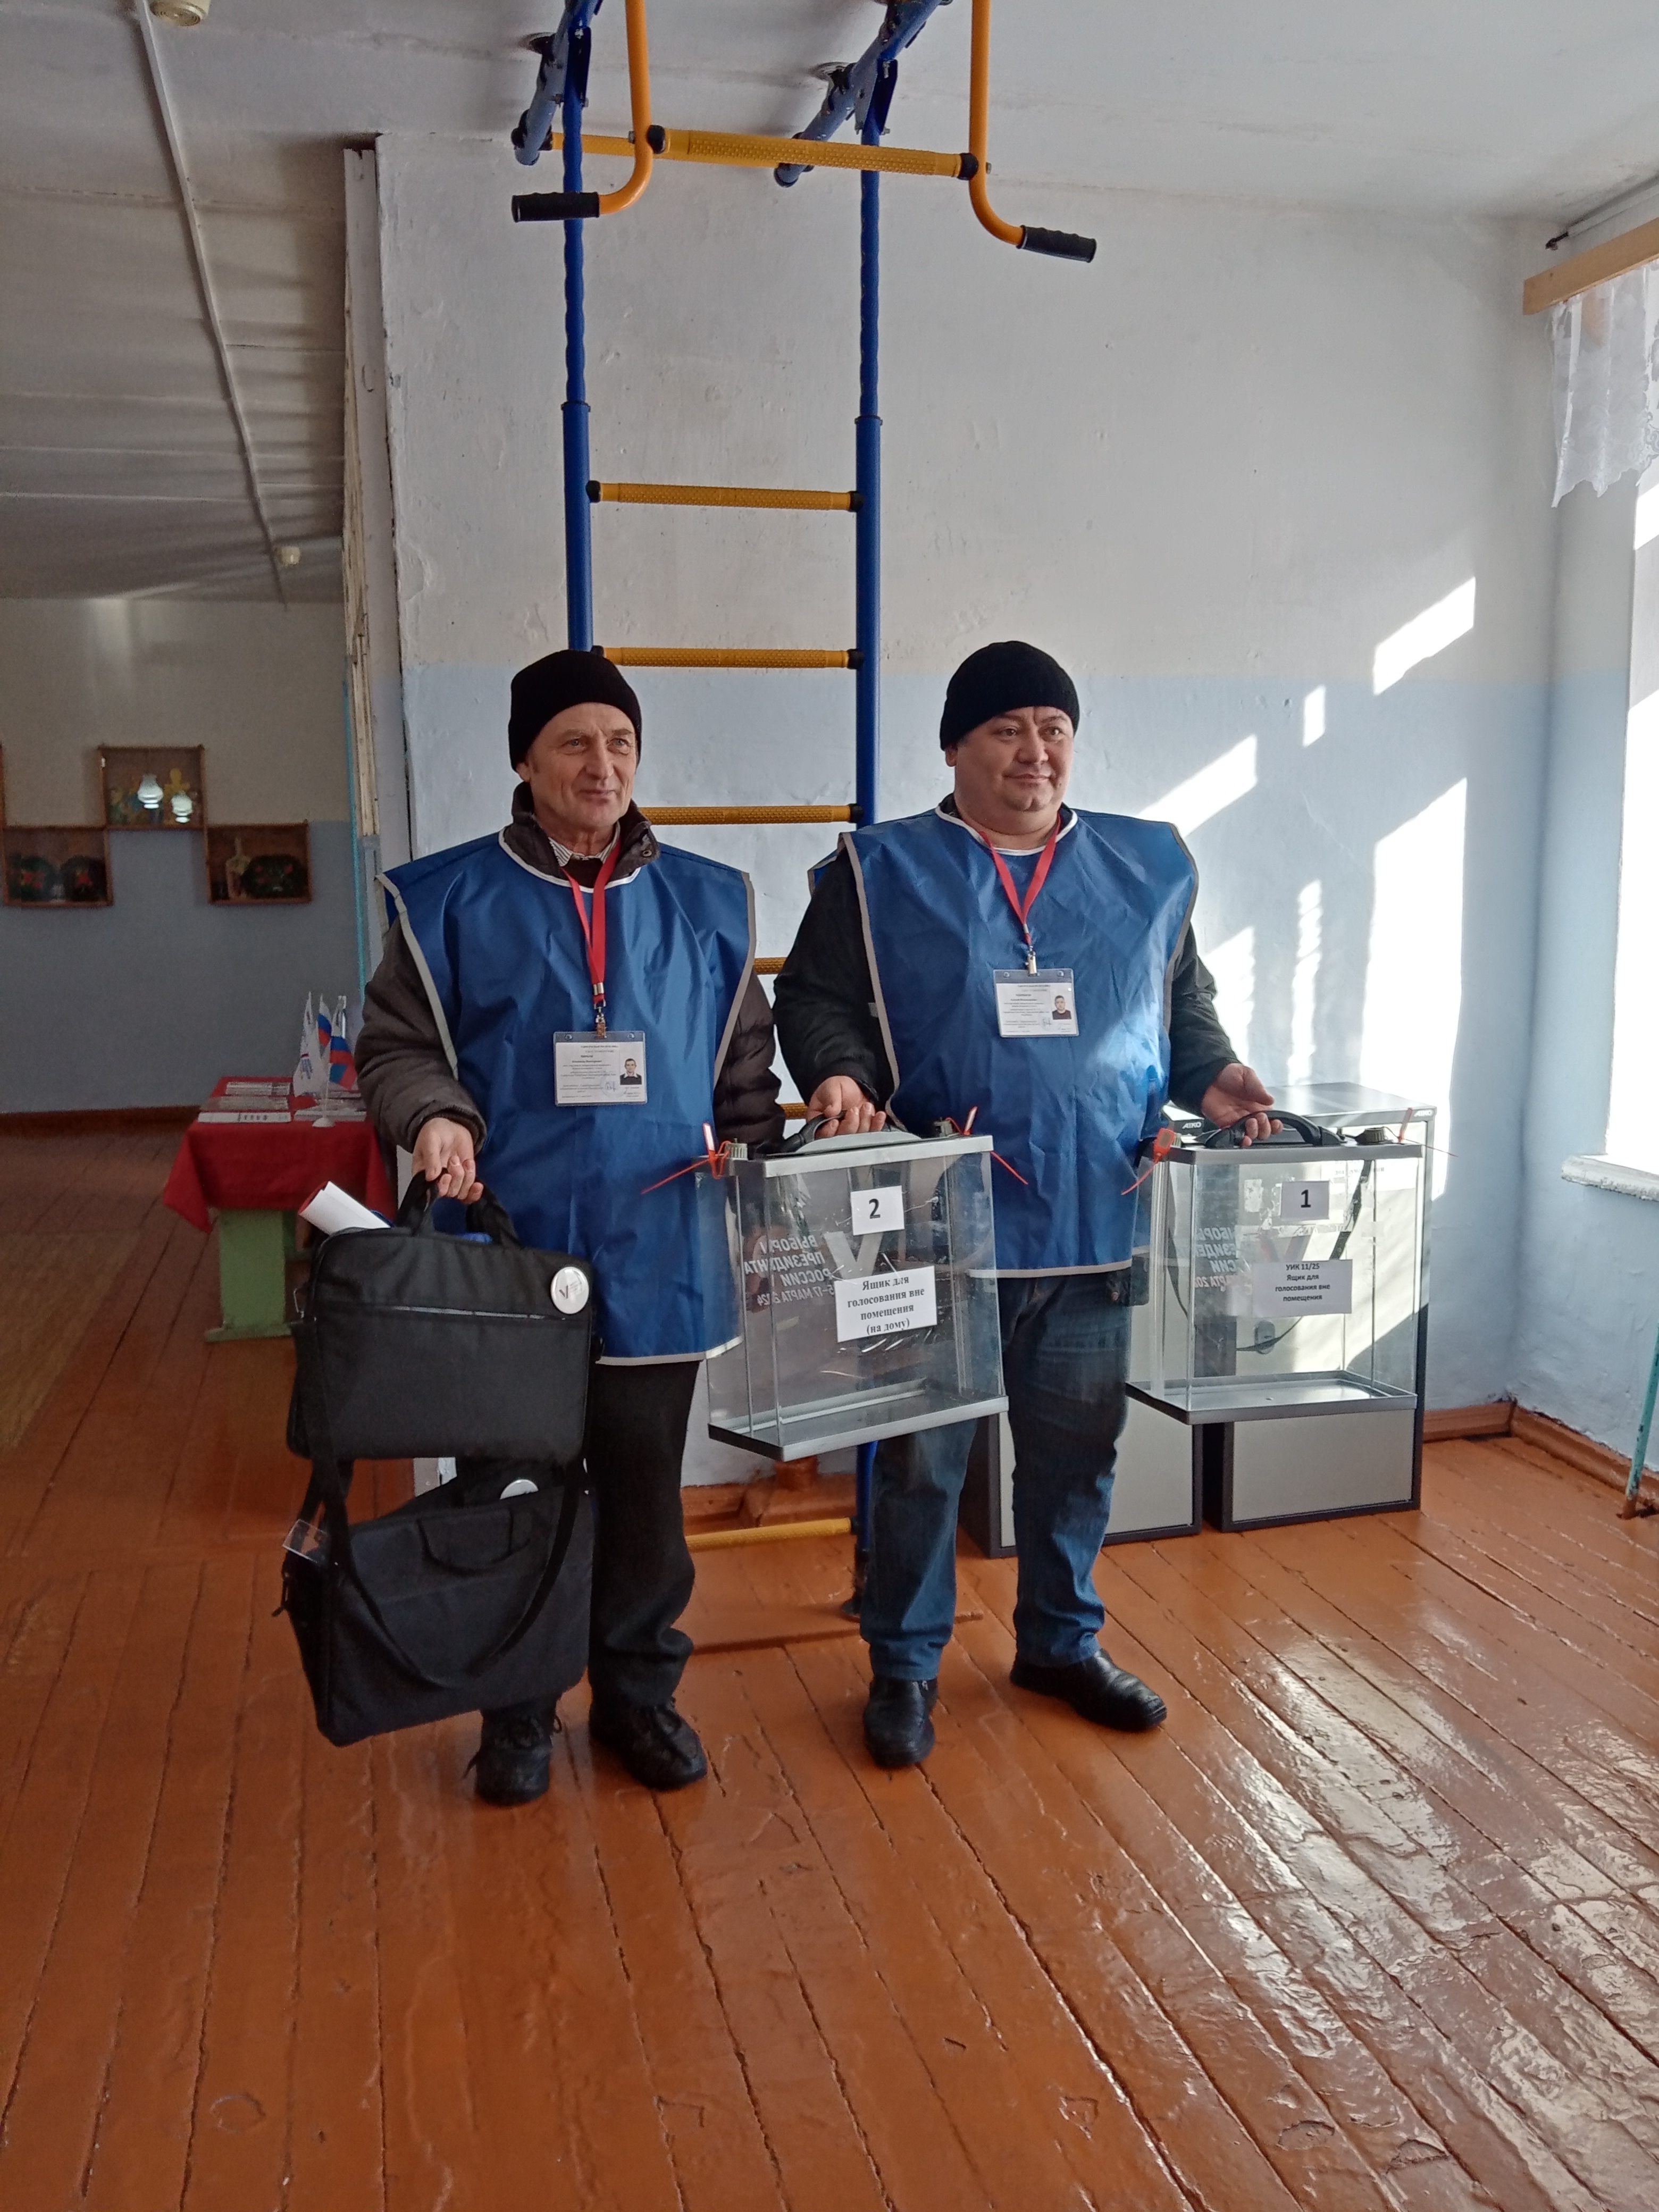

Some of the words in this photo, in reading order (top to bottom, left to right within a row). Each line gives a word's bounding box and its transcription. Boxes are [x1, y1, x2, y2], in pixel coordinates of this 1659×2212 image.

[1301, 1189, 1311, 1208] 1
[868, 1199, 881, 1219] 2
[862, 1278, 891, 1291] Ящик
[892, 1277, 909, 1286] для
[848, 1292, 907, 1308] голосования
[909, 1288, 925, 1297] вне
[860, 1304, 914, 1320] помещения
[866, 1324, 882, 1335] (на
[883, 1318, 910, 1331] дому)
